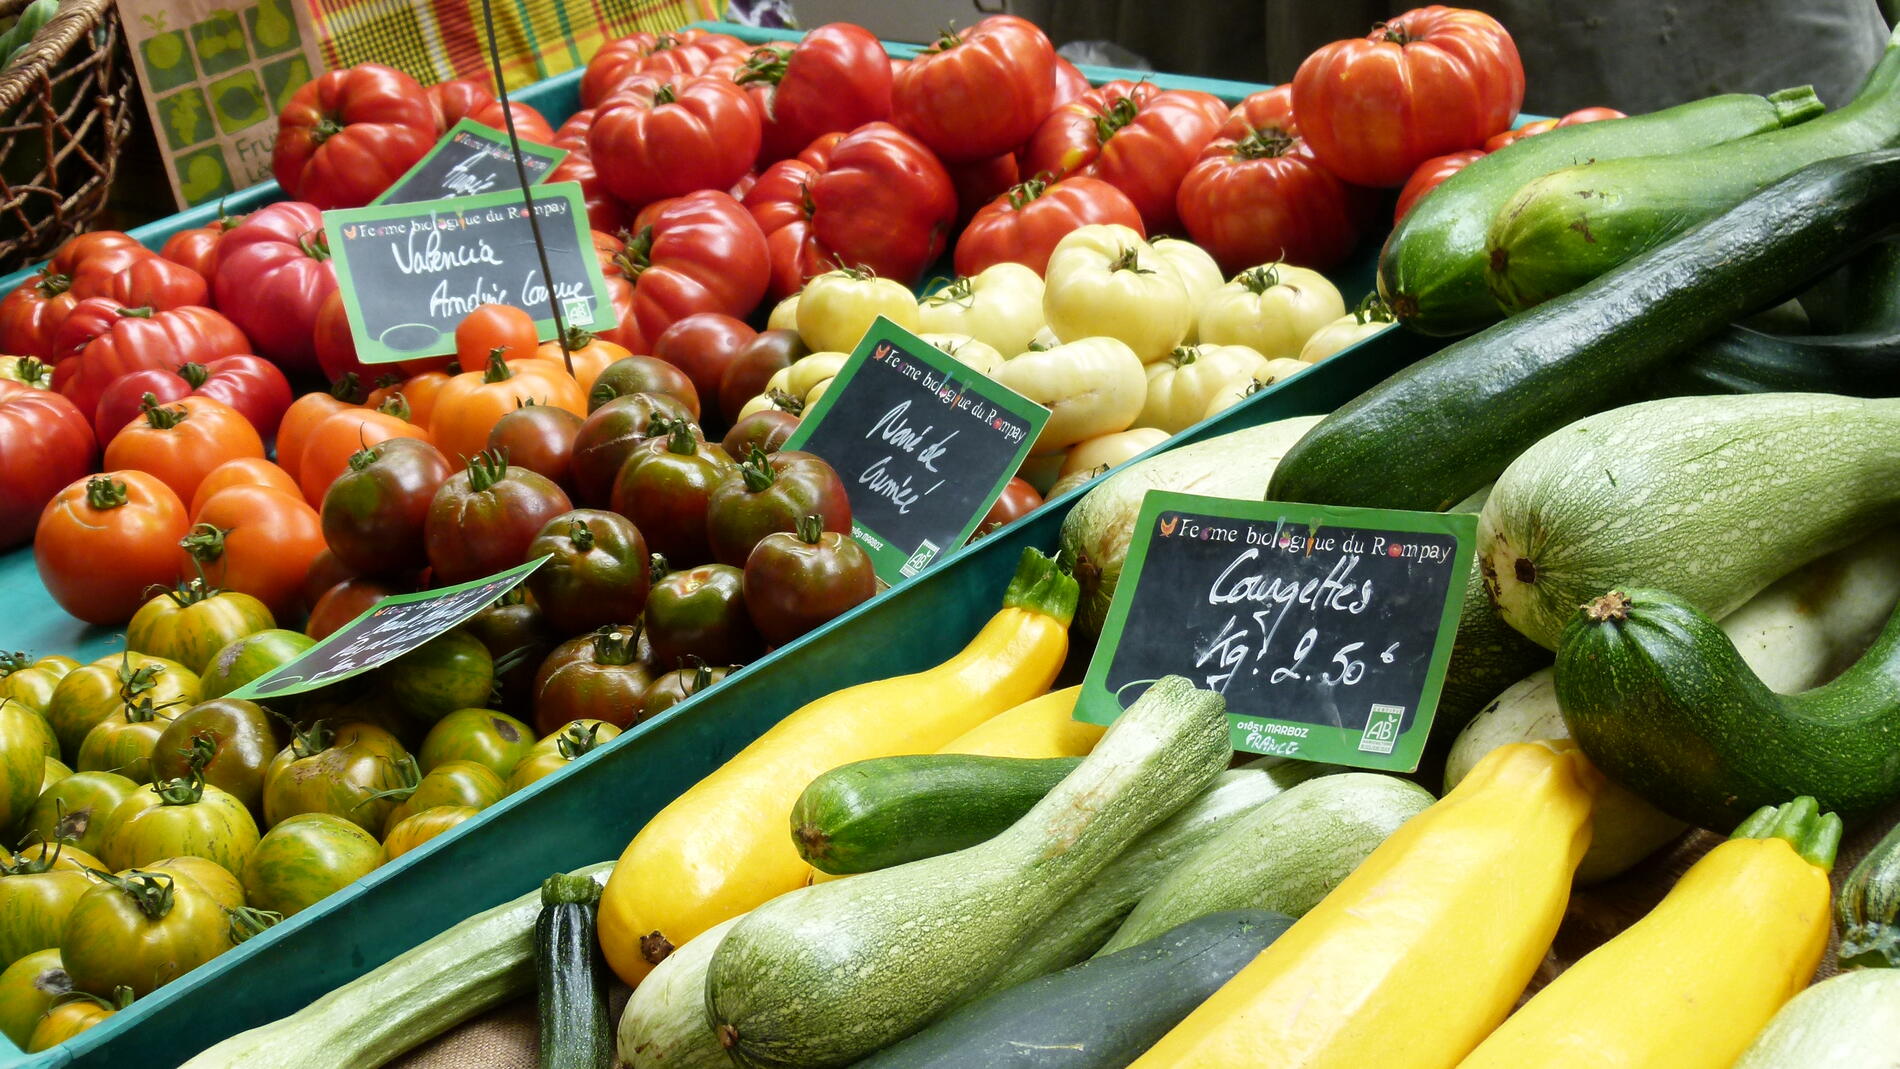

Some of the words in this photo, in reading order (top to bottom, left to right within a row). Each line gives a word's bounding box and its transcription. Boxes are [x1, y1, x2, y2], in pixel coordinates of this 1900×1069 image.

[487, 208, 503, 222] du
[391, 230, 503, 274] Valencia
[885, 349, 921, 381] Ferme
[971, 397, 985, 419] du
[984, 408, 1027, 446] Rompay
[1178, 518, 1238, 542] Ferme
[1246, 519, 1336, 556] biologique
[1342, 535, 1365, 555] du
[1371, 536, 1453, 564] Rompay
[1209, 548, 1373, 661] Courgettes
[1237, 721, 1263, 733] 01851
[1264, 723, 1310, 738] MARBOZ
[1366, 720, 1393, 739] AB
